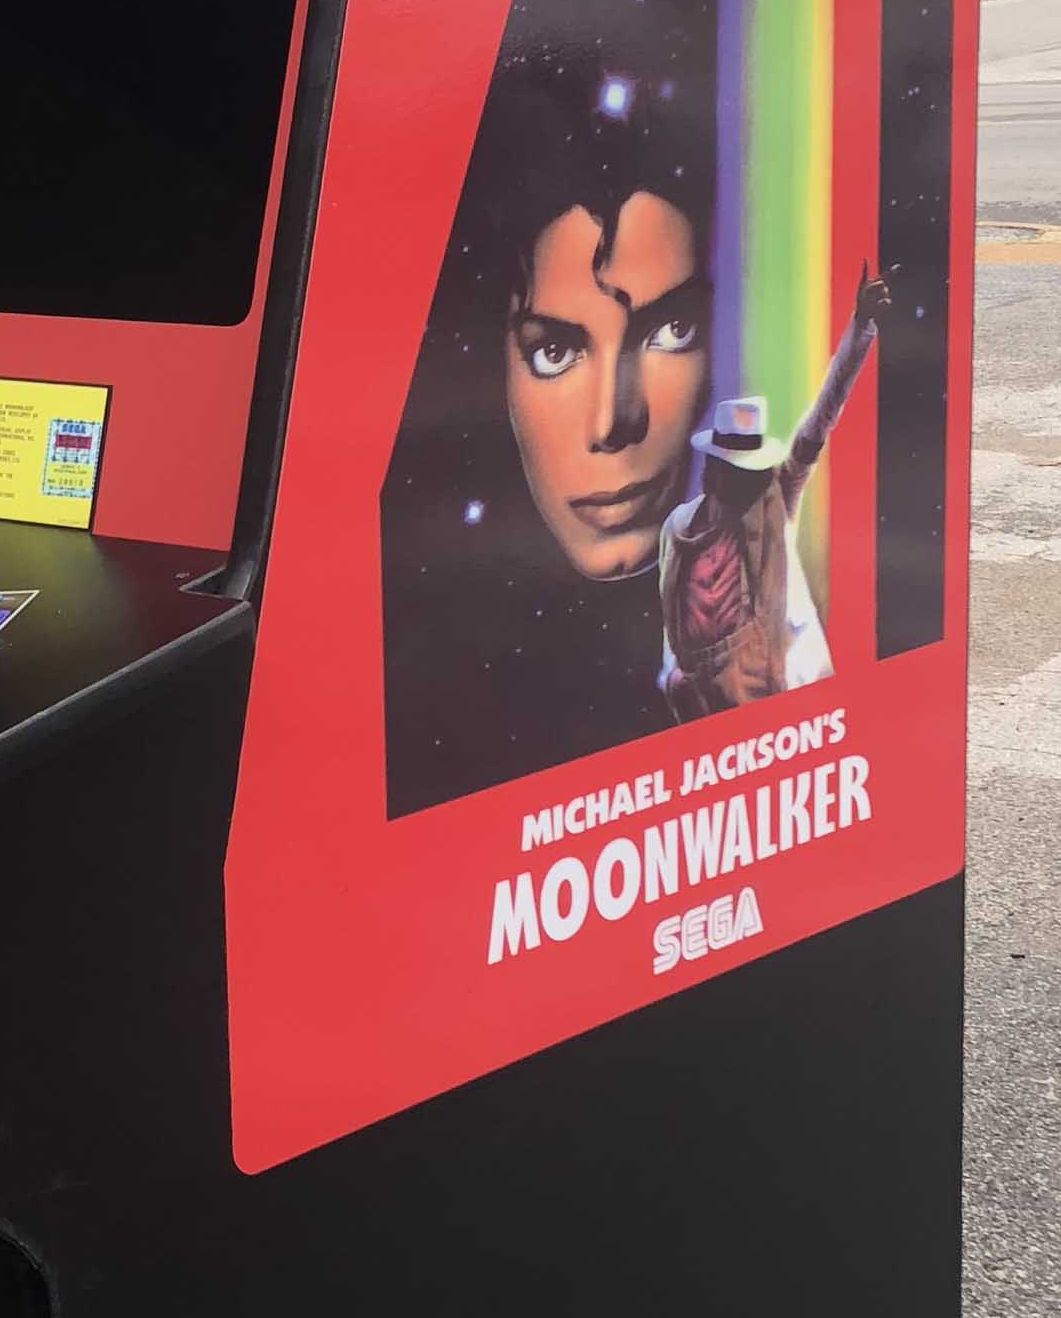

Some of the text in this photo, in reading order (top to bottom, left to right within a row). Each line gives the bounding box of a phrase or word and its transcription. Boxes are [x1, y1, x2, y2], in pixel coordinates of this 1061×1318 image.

[521, 707, 846, 851] MICHAEL JACKSON'S
[487, 754, 872, 965] MOONWALKER
[652, 886, 764, 975] SEGA
